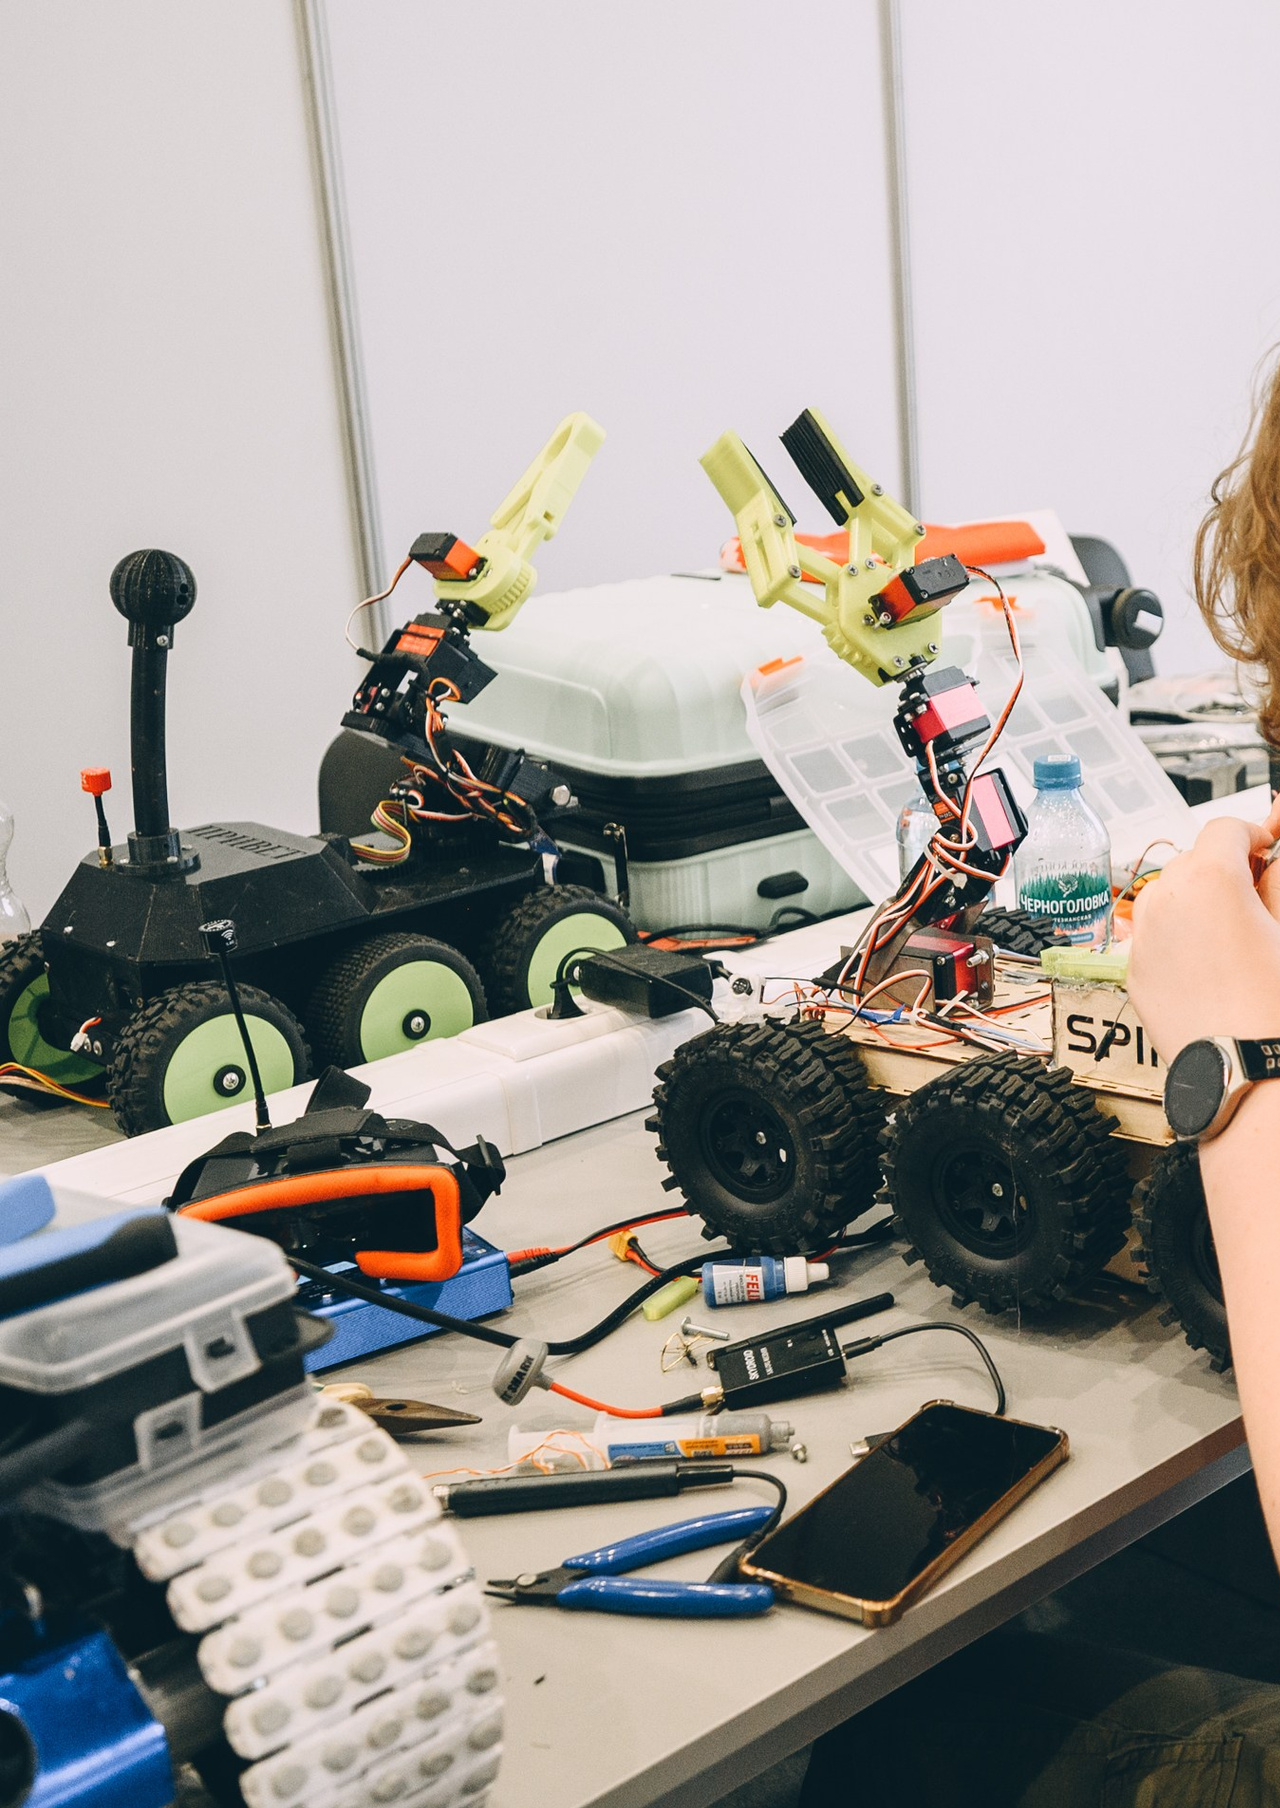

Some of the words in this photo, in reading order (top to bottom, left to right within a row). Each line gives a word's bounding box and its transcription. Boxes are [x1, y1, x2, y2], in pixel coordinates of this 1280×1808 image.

[1020, 890, 1110, 915] ЧЕРНОГОЛОВКА
[1065, 1013, 1158, 1068] SPI
[745, 1274, 761, 1301] FELI
[742, 1349, 760, 1381] SKYDROID
